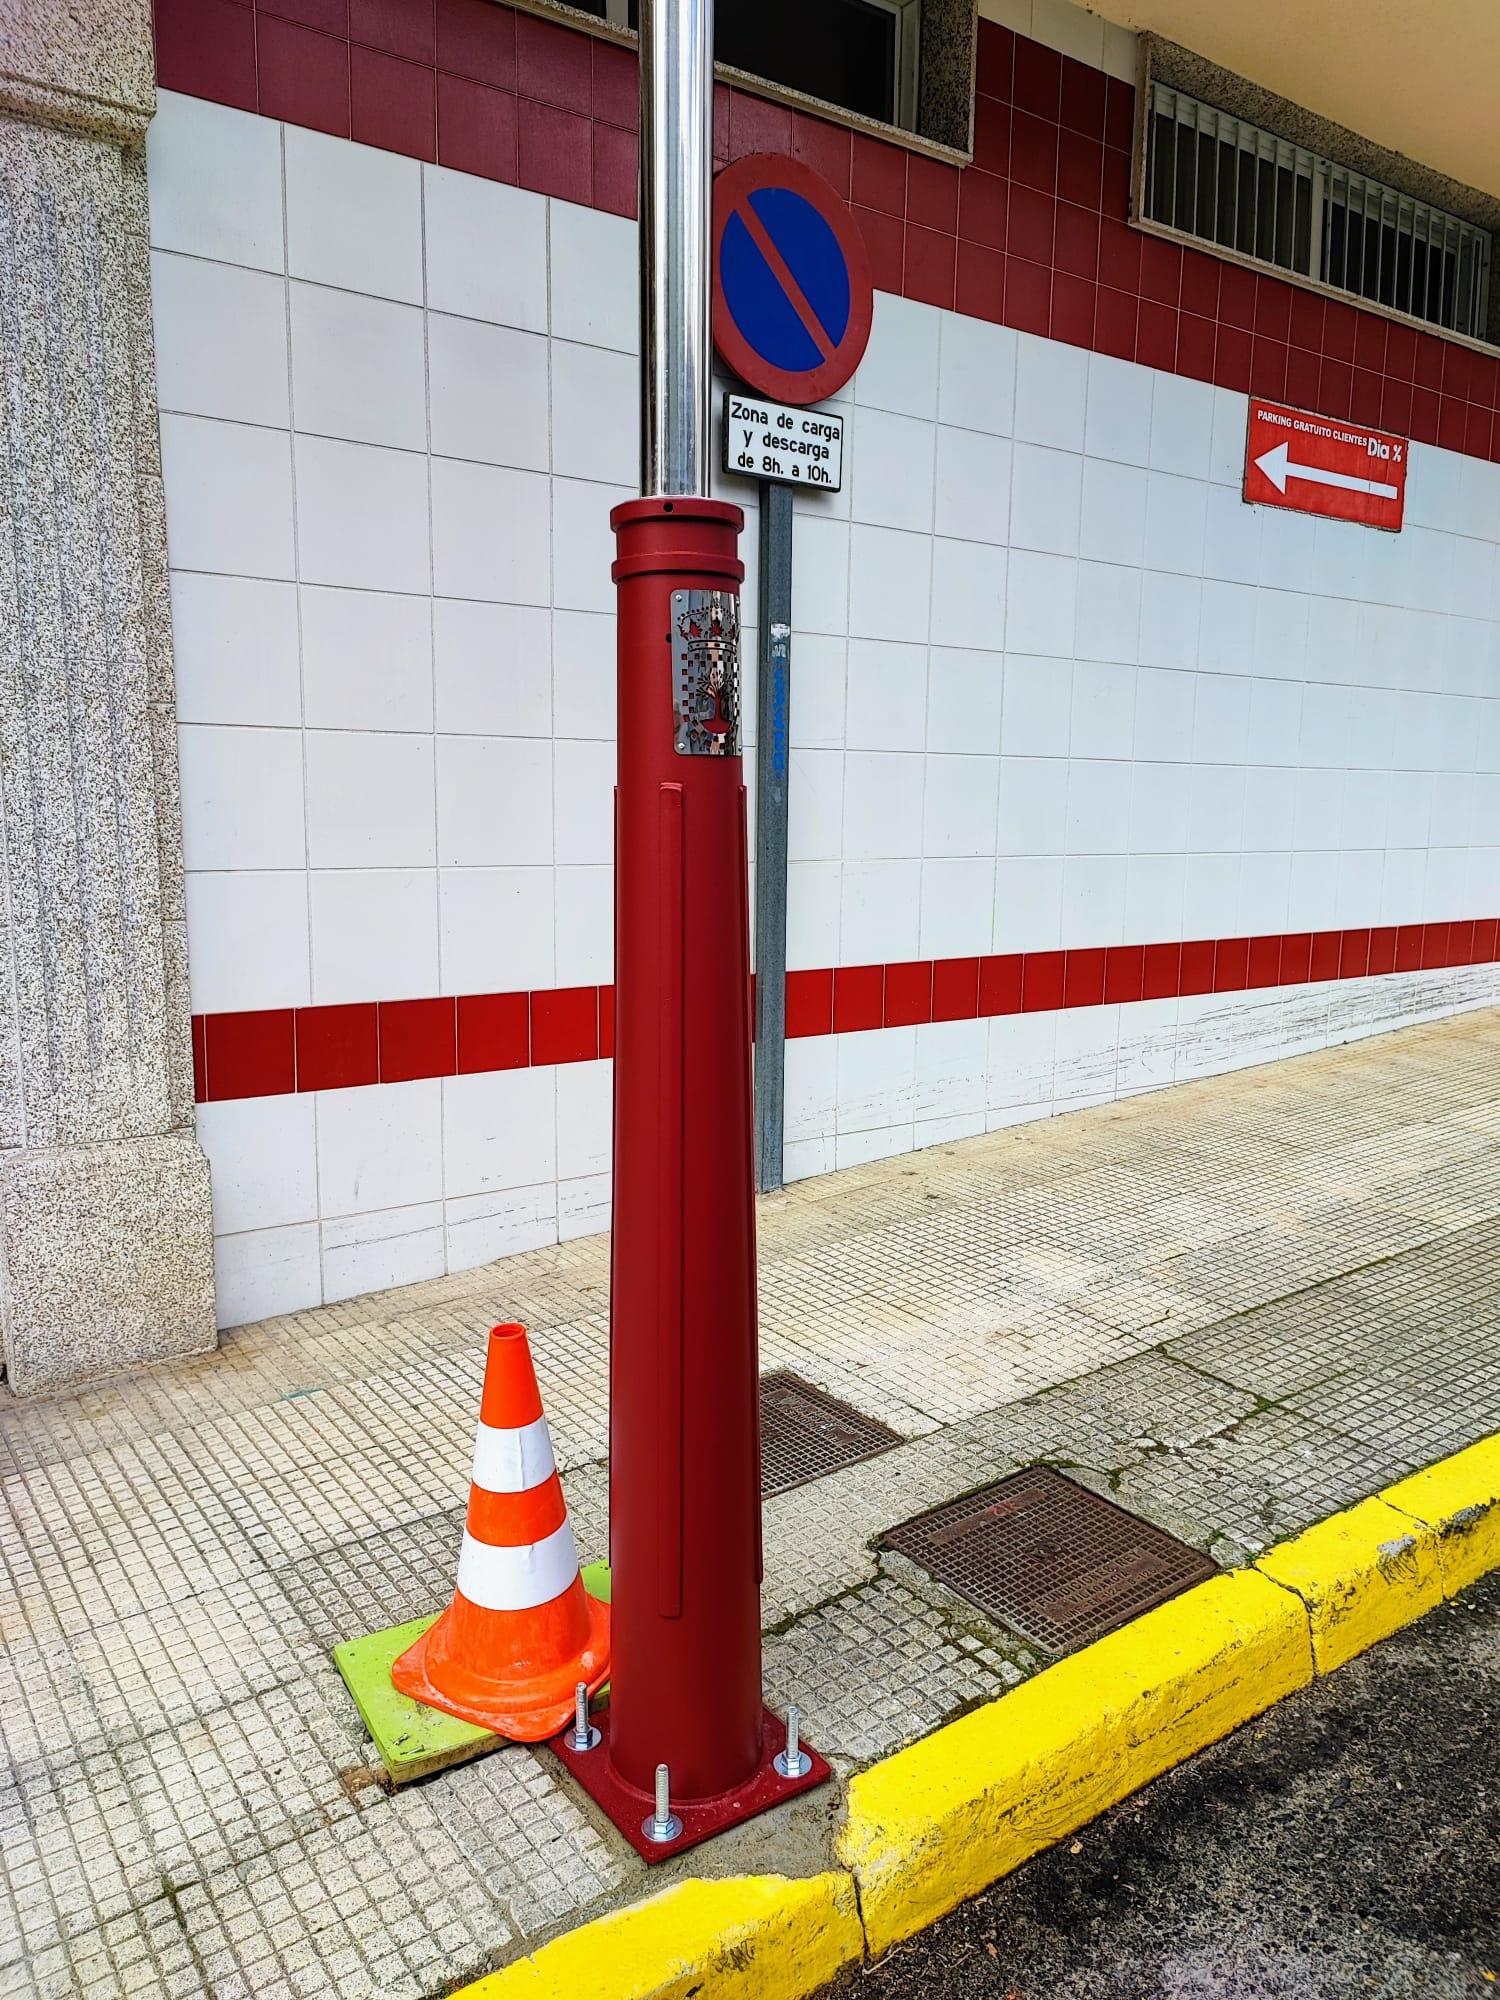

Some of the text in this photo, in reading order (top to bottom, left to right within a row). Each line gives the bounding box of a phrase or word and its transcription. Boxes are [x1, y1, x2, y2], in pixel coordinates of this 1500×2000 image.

[731, 402, 840, 442] Zona de carga
[1258, 410, 1292, 428] PARKING
[1294, 420, 1331, 438] GRATUITO
[1333, 430, 1367, 447] CLIENTES
[1367, 437, 1389, 460] Dia
[743, 430, 829, 461] y descarga
[738, 452, 832, 484] de 8h. a 10h.
[1115, 1551, 1142, 1569] REY
